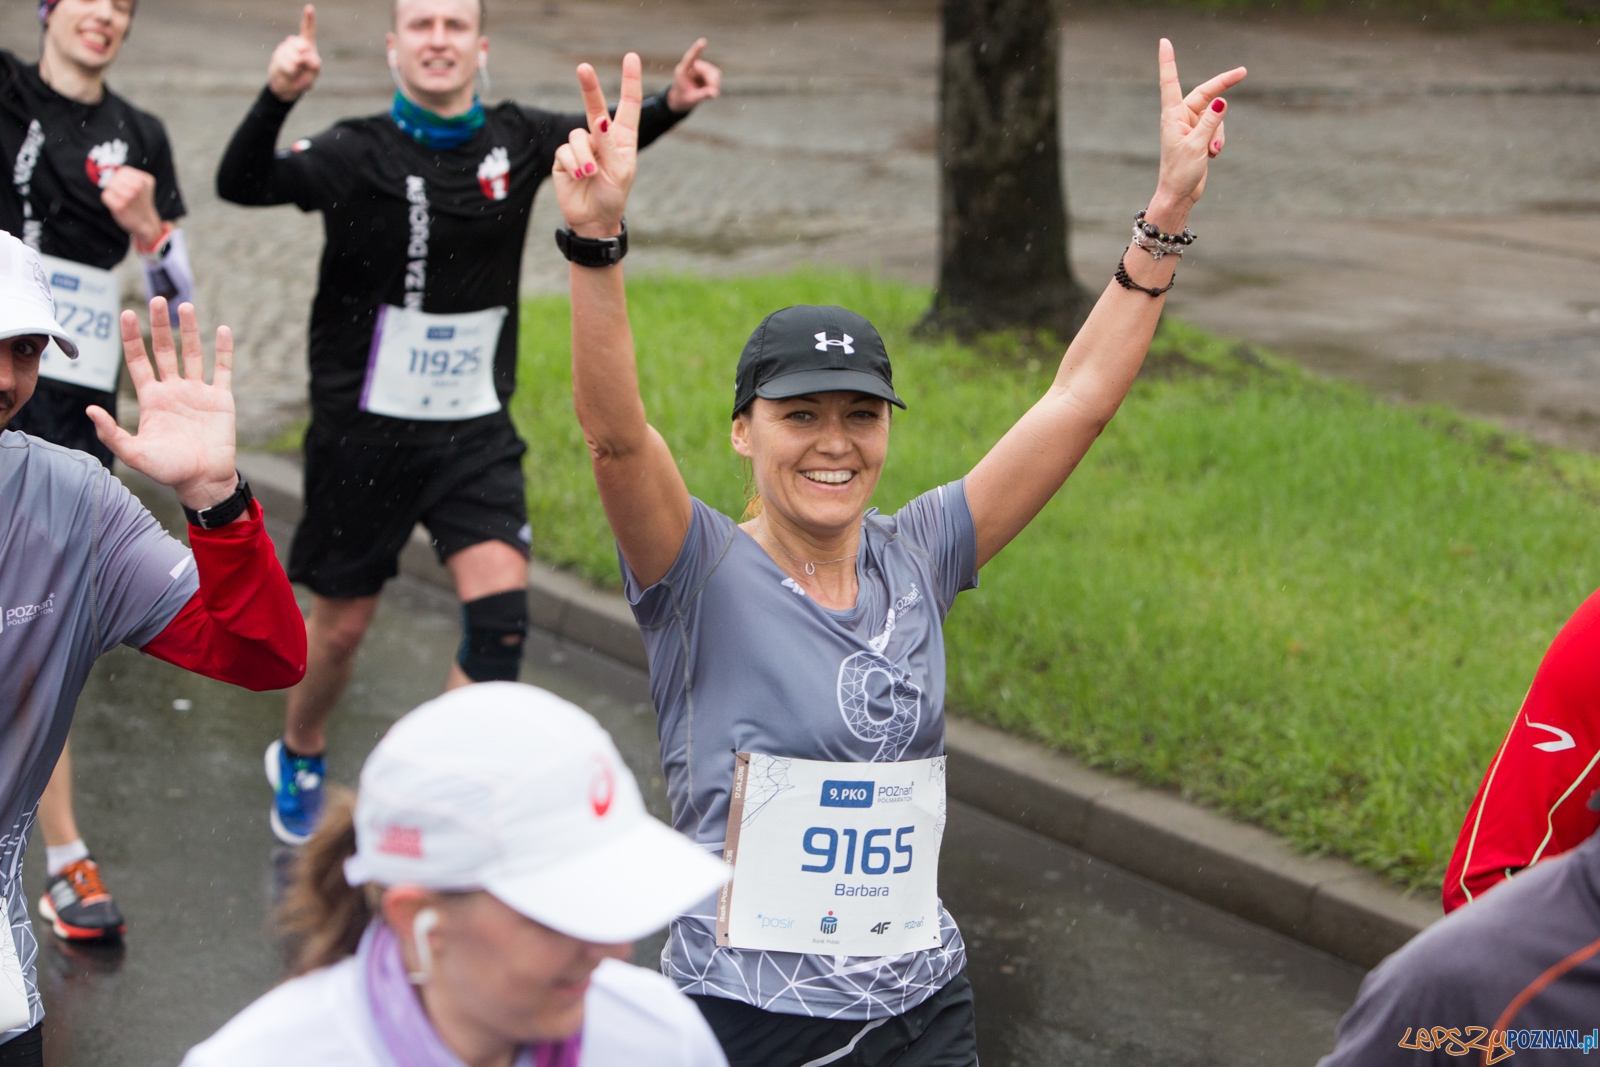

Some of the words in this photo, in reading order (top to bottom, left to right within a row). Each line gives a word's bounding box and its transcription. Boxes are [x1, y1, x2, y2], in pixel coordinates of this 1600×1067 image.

[54, 301, 112, 340] 728
[734, 766, 745, 799] 17.04.2016
[801, 825, 915, 875] 9165
[834, 883, 890, 897] Barbara
